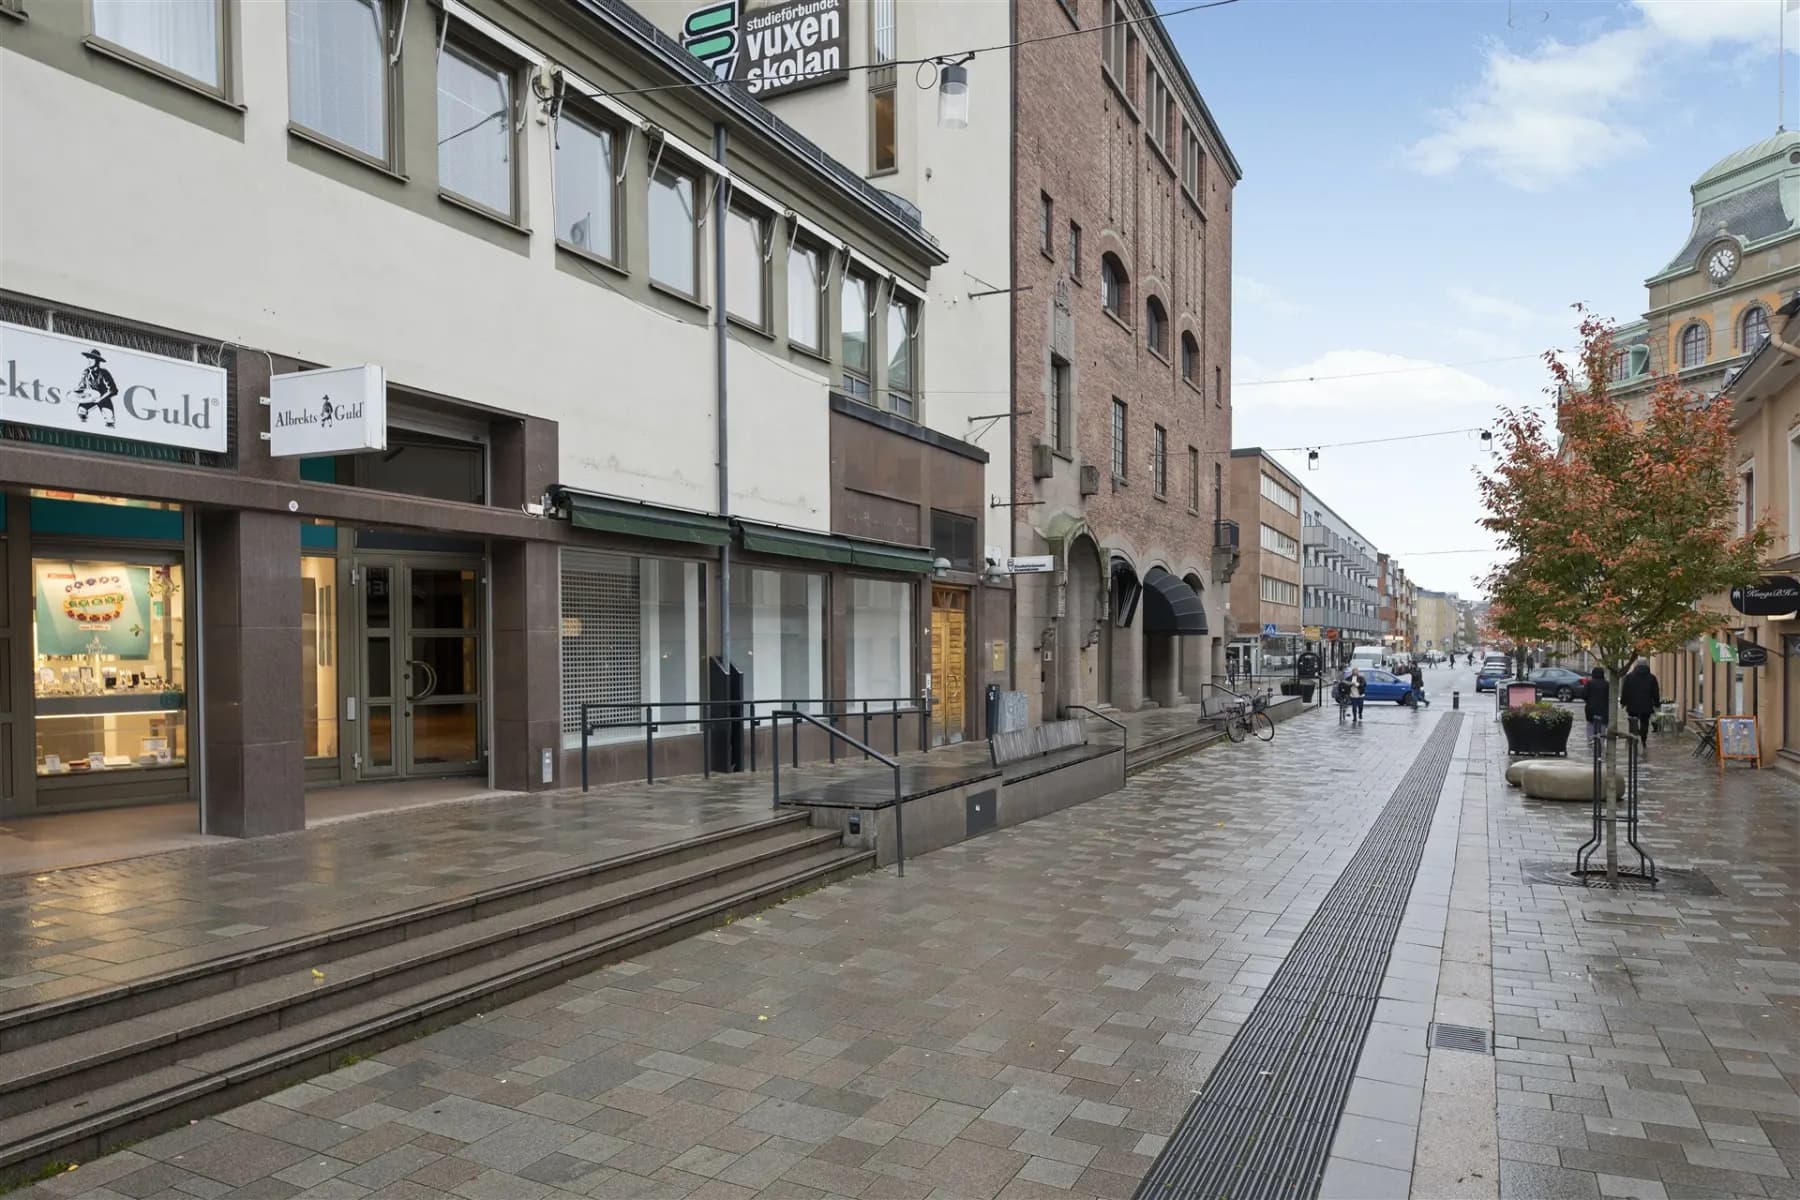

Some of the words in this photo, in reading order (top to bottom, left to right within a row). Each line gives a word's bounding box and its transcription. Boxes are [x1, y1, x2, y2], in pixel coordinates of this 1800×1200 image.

[747, 0, 839, 31] studieförbundet
[746, 10, 839, 61] vuxen
[747, 46, 839, 94] skolan
[275, 408, 318, 428] Albrekts
